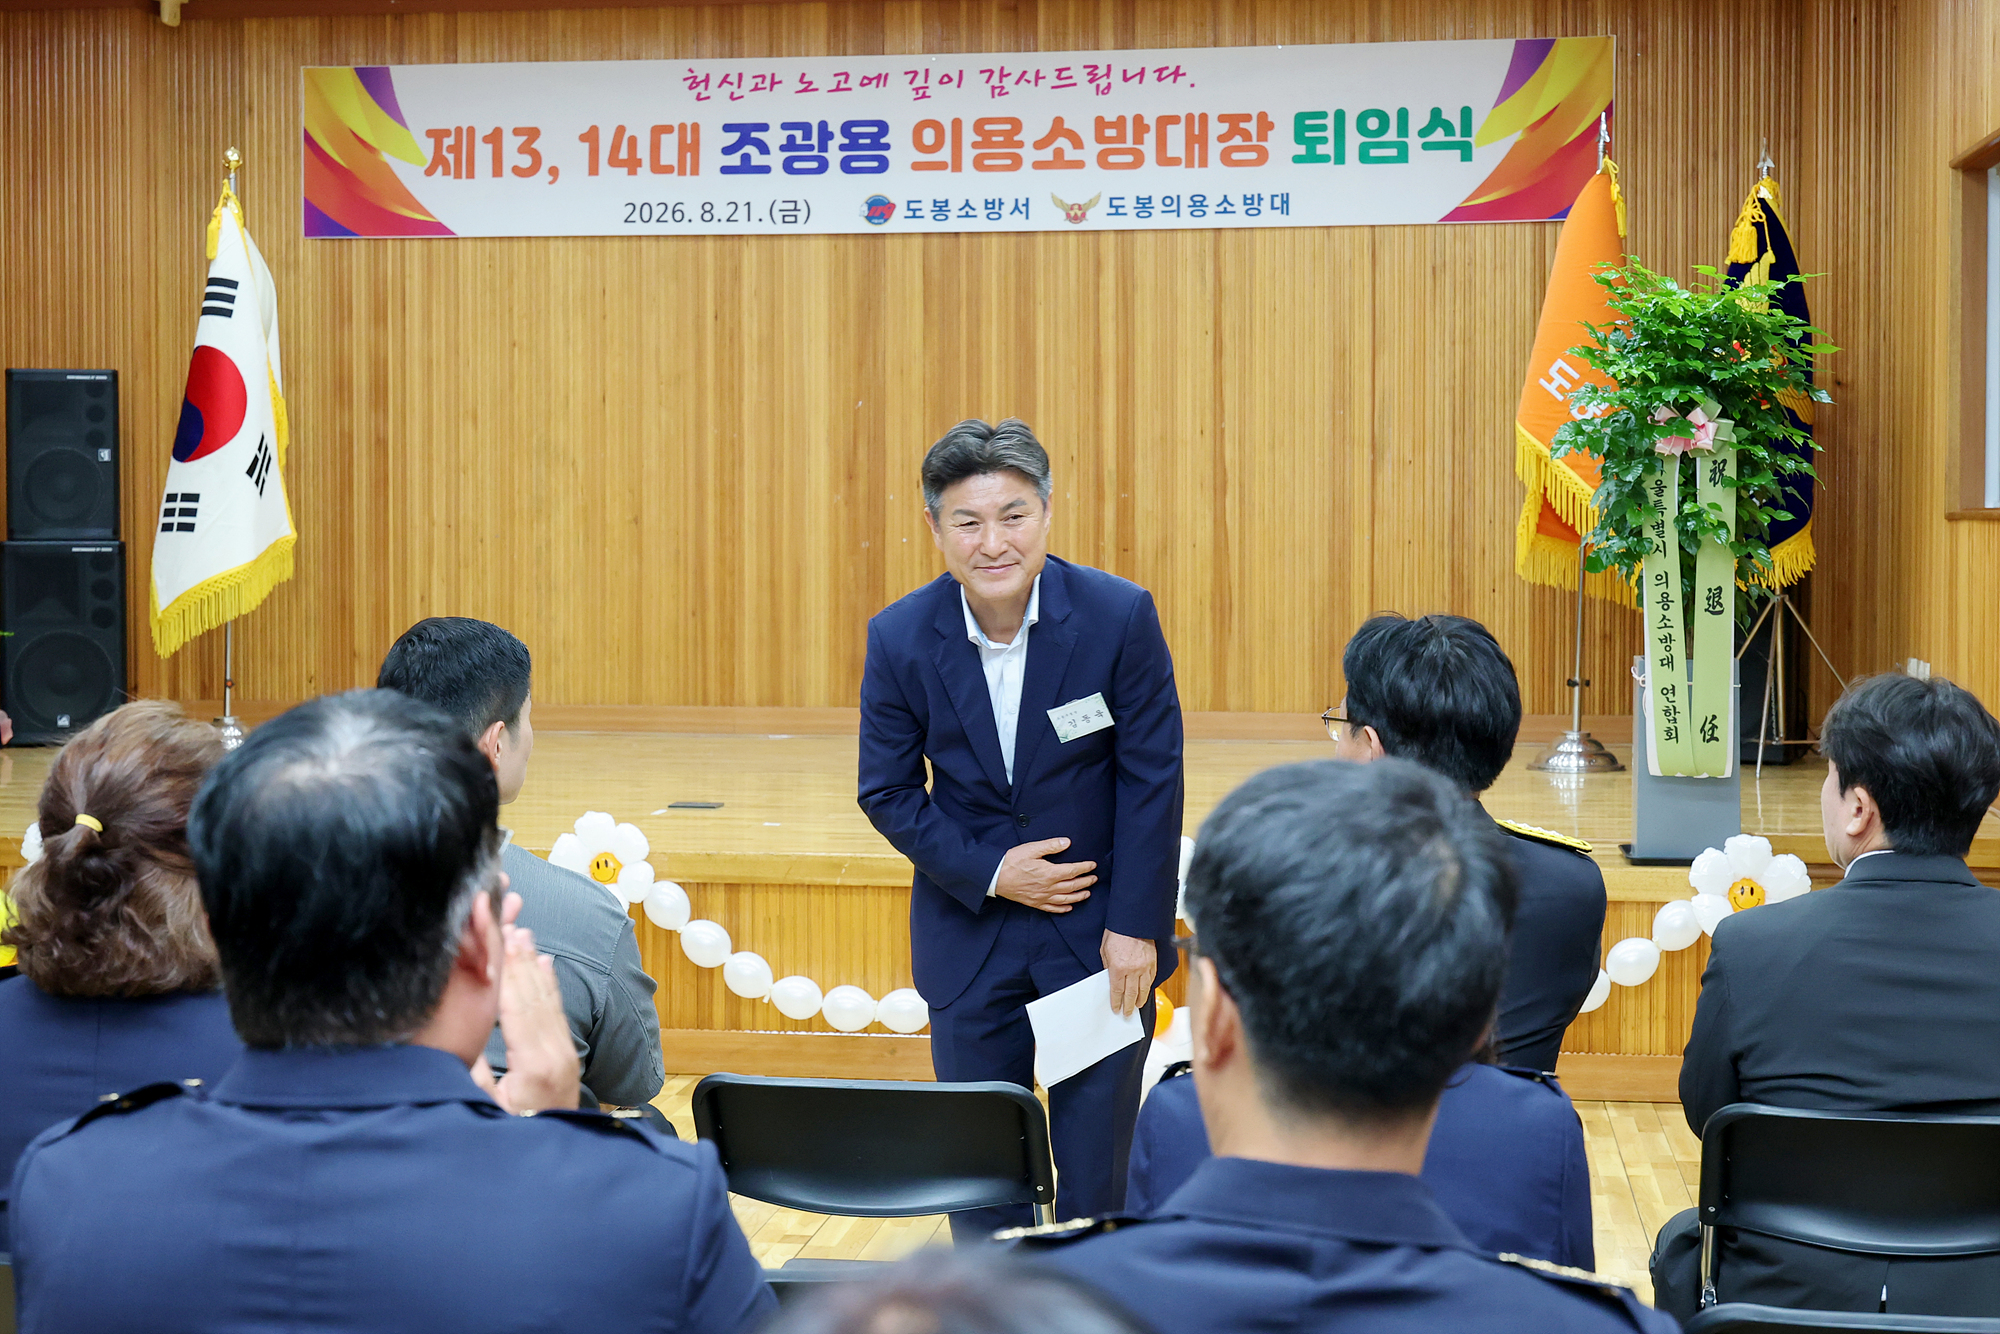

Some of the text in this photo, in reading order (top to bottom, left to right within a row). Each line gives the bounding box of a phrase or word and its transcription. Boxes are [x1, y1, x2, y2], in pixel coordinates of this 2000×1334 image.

[683, 63, 1196, 101] 헌신과 노고에 깊이 감사드립니다.
[424, 105, 1473, 185] 제13, 14대 조광용 의용소방대장 퇴임식
[903, 197, 1030, 222] 도봉소방서
[1106, 192, 1291, 219] 도봉의용소방대
[1654, 570, 1675, 672] 의용소방대
[1660, 683, 1681, 744] 연합회
